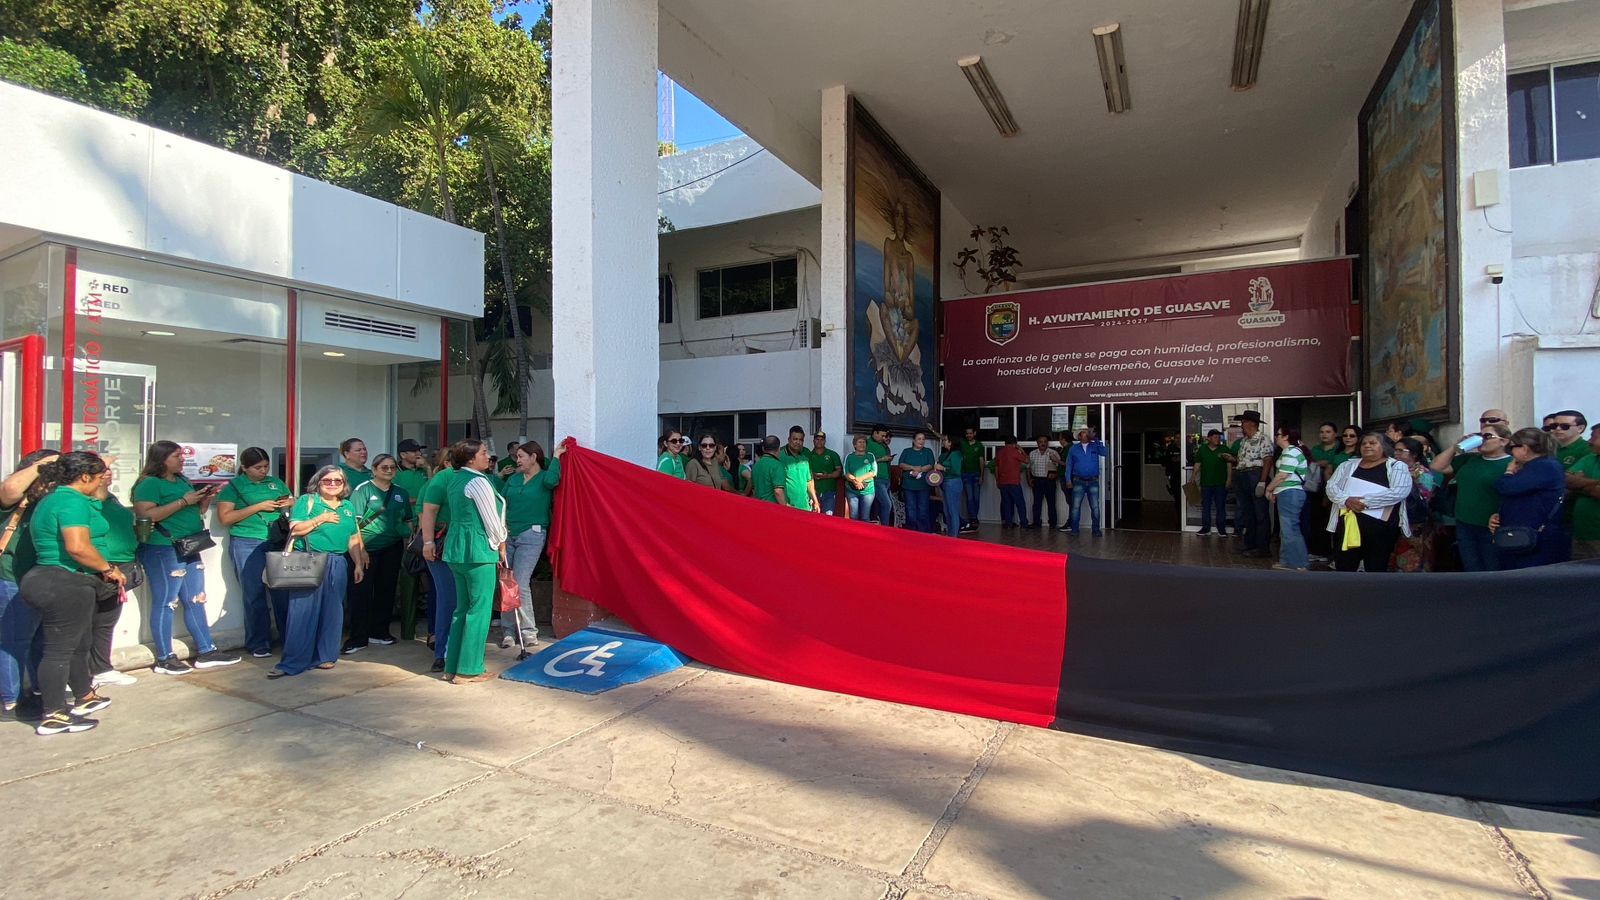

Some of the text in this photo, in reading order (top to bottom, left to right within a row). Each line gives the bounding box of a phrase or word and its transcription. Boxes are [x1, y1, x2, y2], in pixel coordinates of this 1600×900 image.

[103, 283, 129, 294] RED
[88, 293, 102, 324] ATM
[1028, 316, 1040, 326] H.
[1042, 308, 1140, 324] AYUNTAMIENTO
[1143, 305, 1162, 316] DE
[1165, 300, 1231, 314] GUASAVE
[1100, 318, 1148, 327] 2024-2027
[1239, 315, 1284, 325] GUASAVE
[962, 336, 1321, 367] La confianza de la gente se paga con humildad, profesionalismo,
[997, 354, 1272, 376] honestidad y leal desempeño, Guasave lo merece.
[1044, 380, 1071, 391] ¡Aquí
[1114, 379, 1131, 387] con
[1133, 377, 1160, 386] amor
[1162, 375, 1173, 384] al
[1173, 374, 1214, 386] pueblo!
[104, 377, 121, 481] BNORTE
